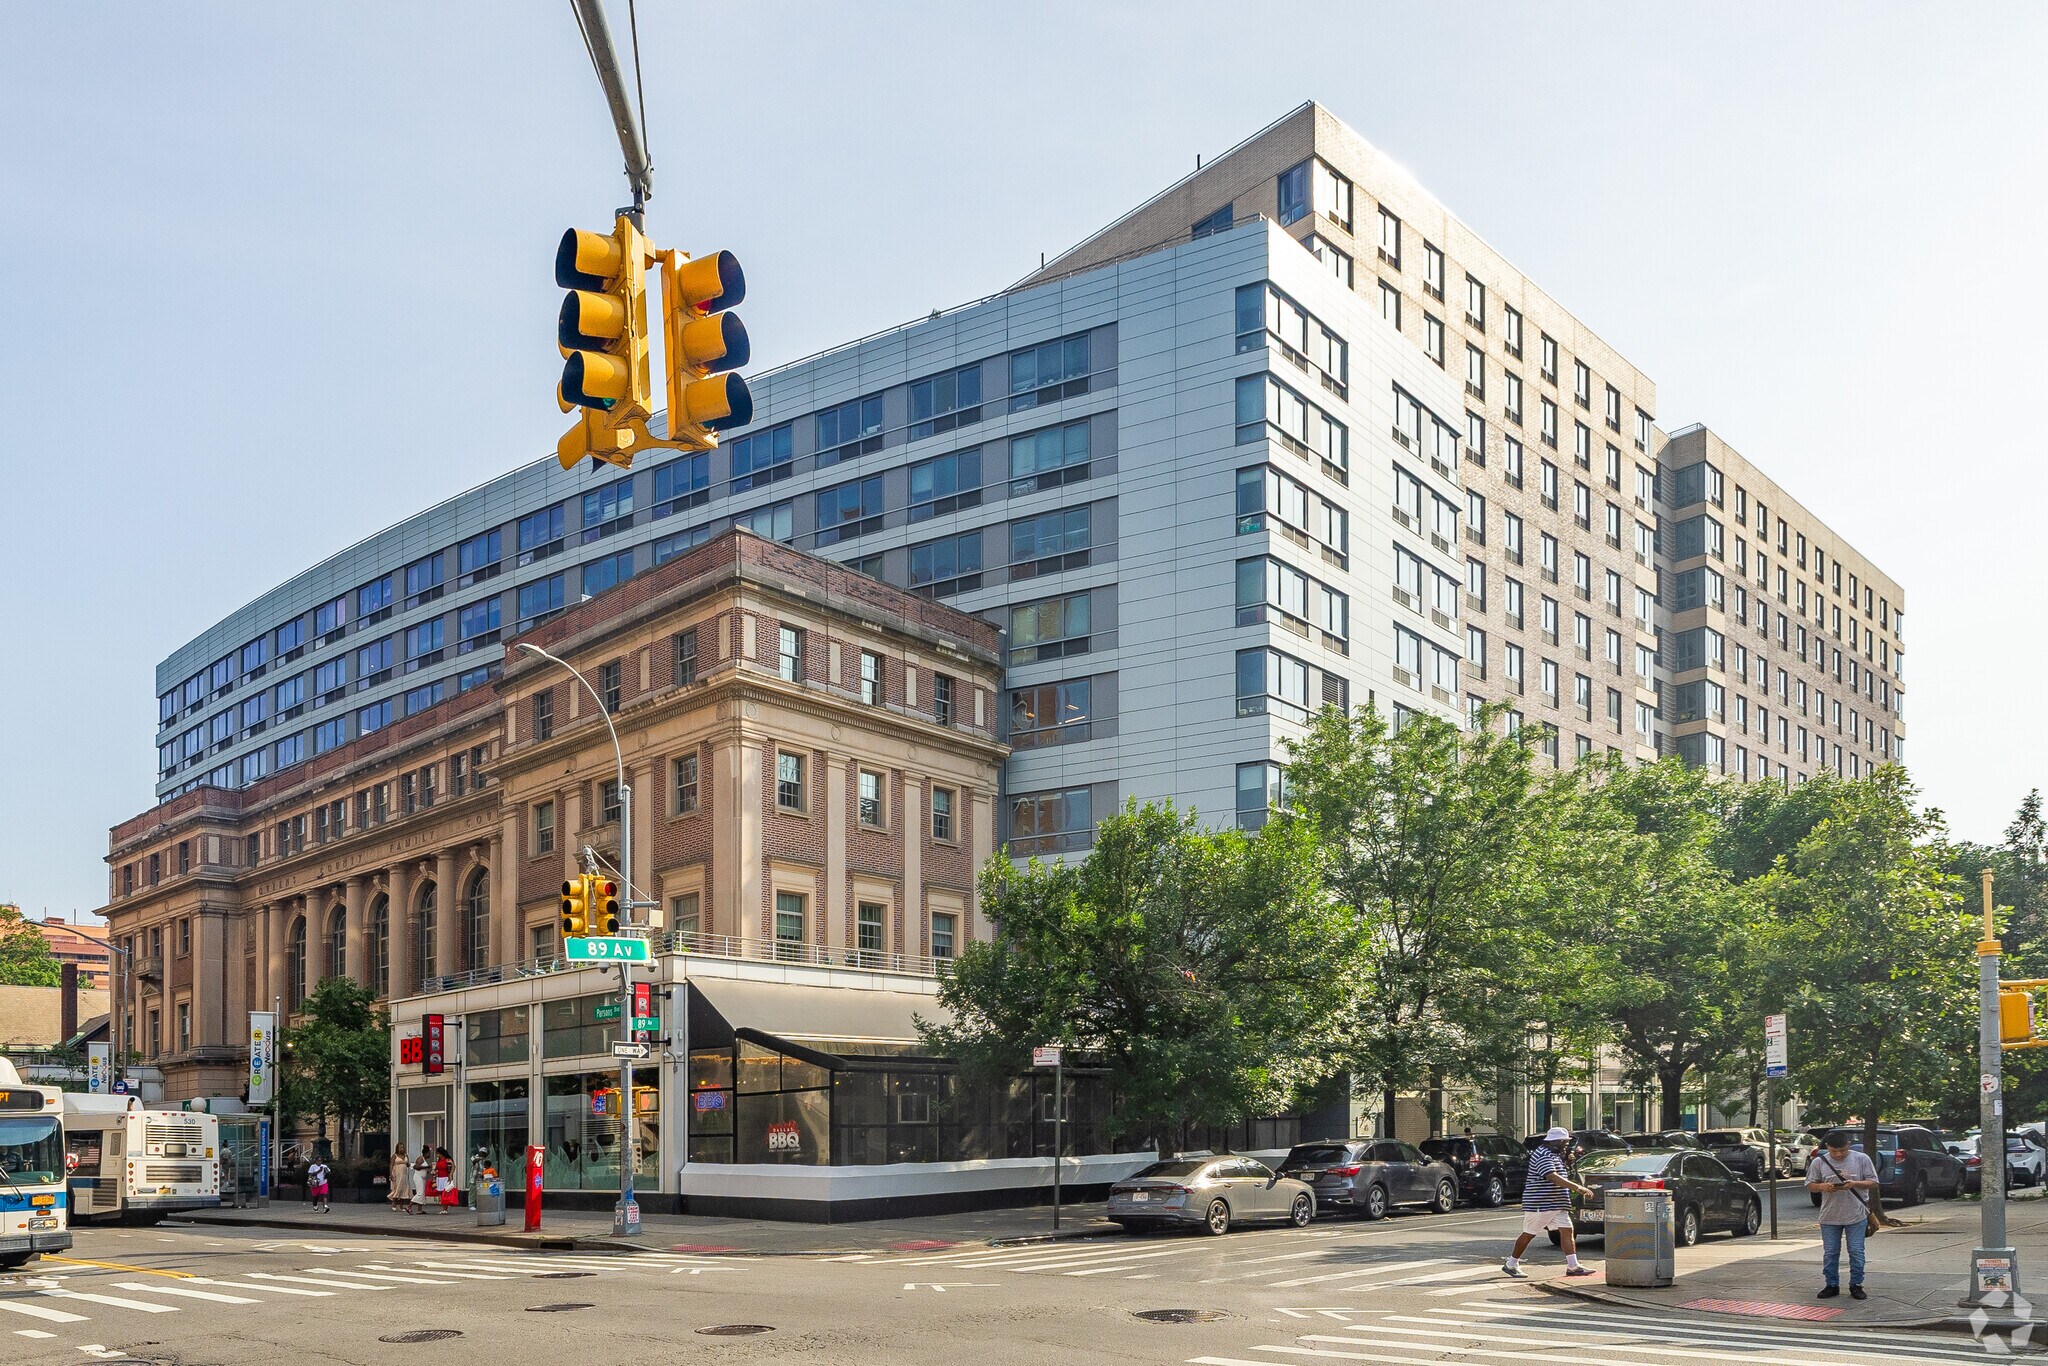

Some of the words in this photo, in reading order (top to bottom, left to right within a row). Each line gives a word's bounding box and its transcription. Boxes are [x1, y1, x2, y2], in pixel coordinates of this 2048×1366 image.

[587, 941, 608, 956] 89
[613, 942, 632, 957] Av
[596, 1008, 613, 1018] Parsons
[637, 1019, 646, 1029] 89
[252, 1030, 262, 1085] GREATER
[401, 1037, 423, 1064] BB
[698, 1095, 724, 1109] BBQ
[769, 1132, 800, 1148] BBQ
